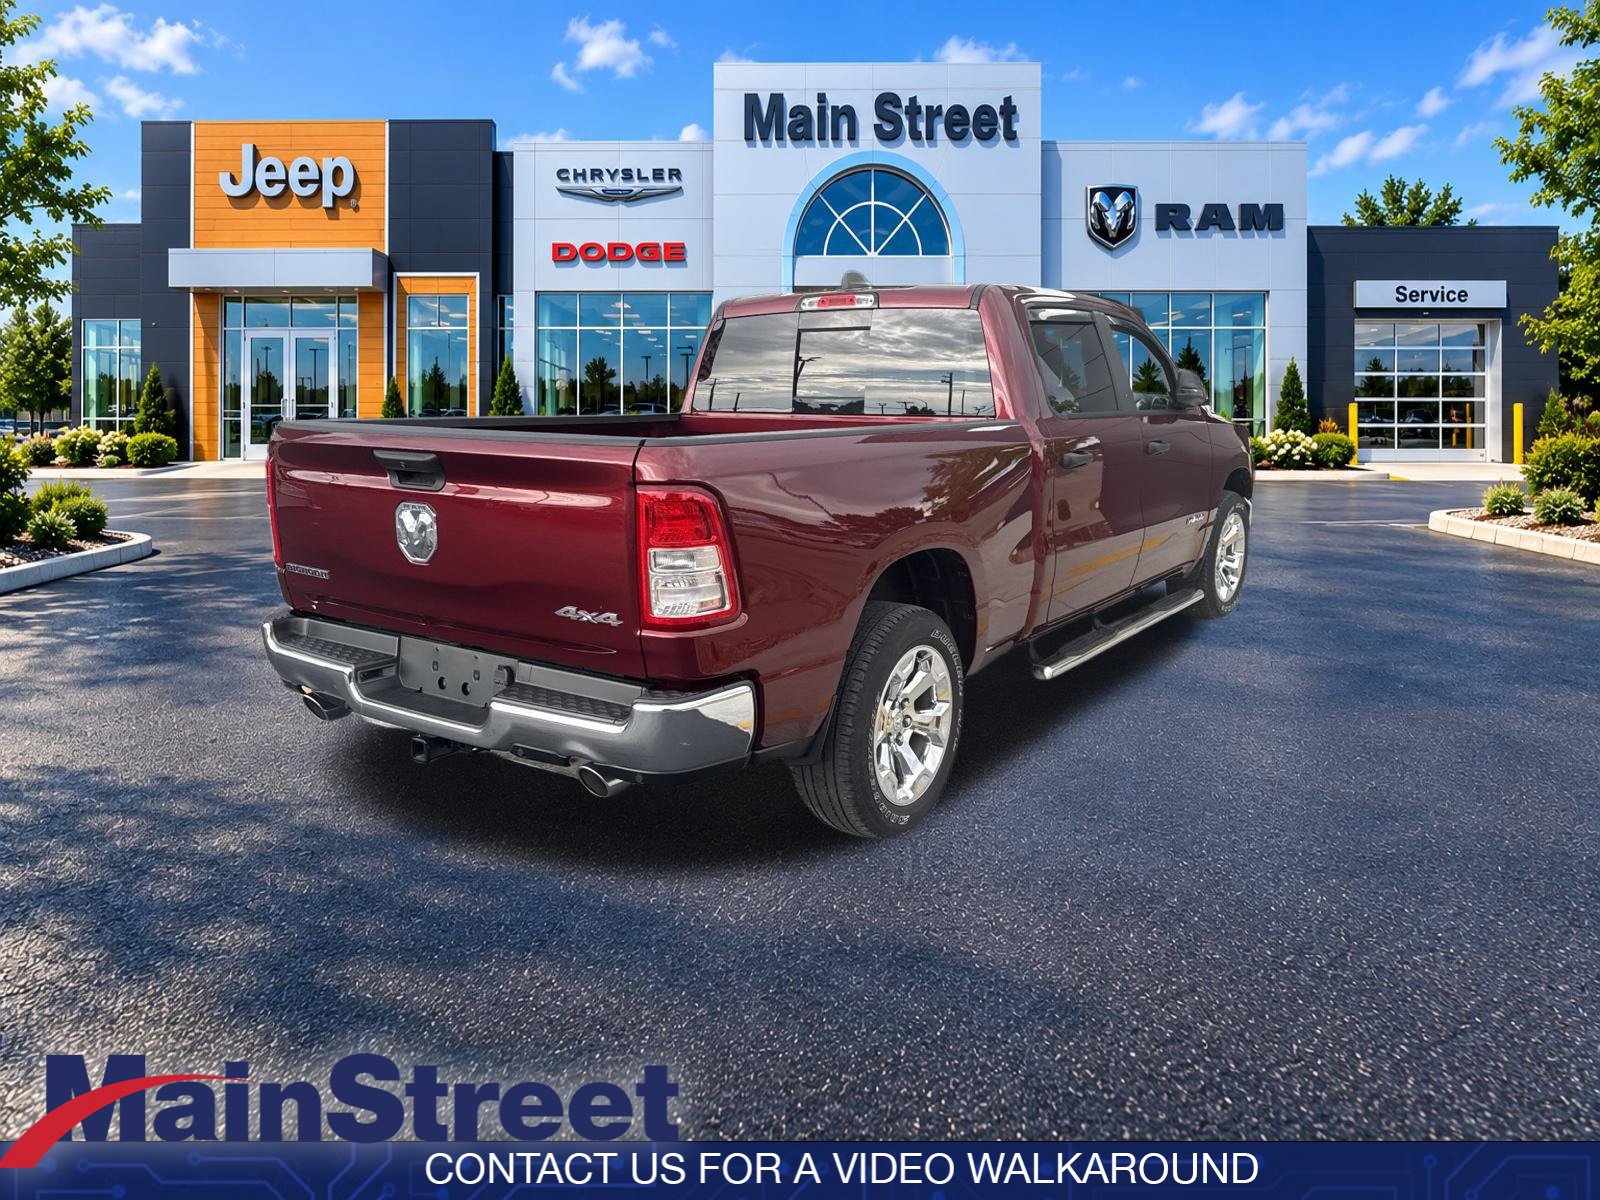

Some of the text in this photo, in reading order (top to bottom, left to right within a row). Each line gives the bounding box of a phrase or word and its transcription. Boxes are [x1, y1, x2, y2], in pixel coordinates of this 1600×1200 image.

[743, 91, 1018, 141] Main Street
[218, 143, 354, 208] Jeep
[556, 168, 683, 182] CHRYSLER
[1155, 203, 1284, 231] RAM
[551, 242, 687, 262] DODGE
[1395, 285, 1469, 303] Service
